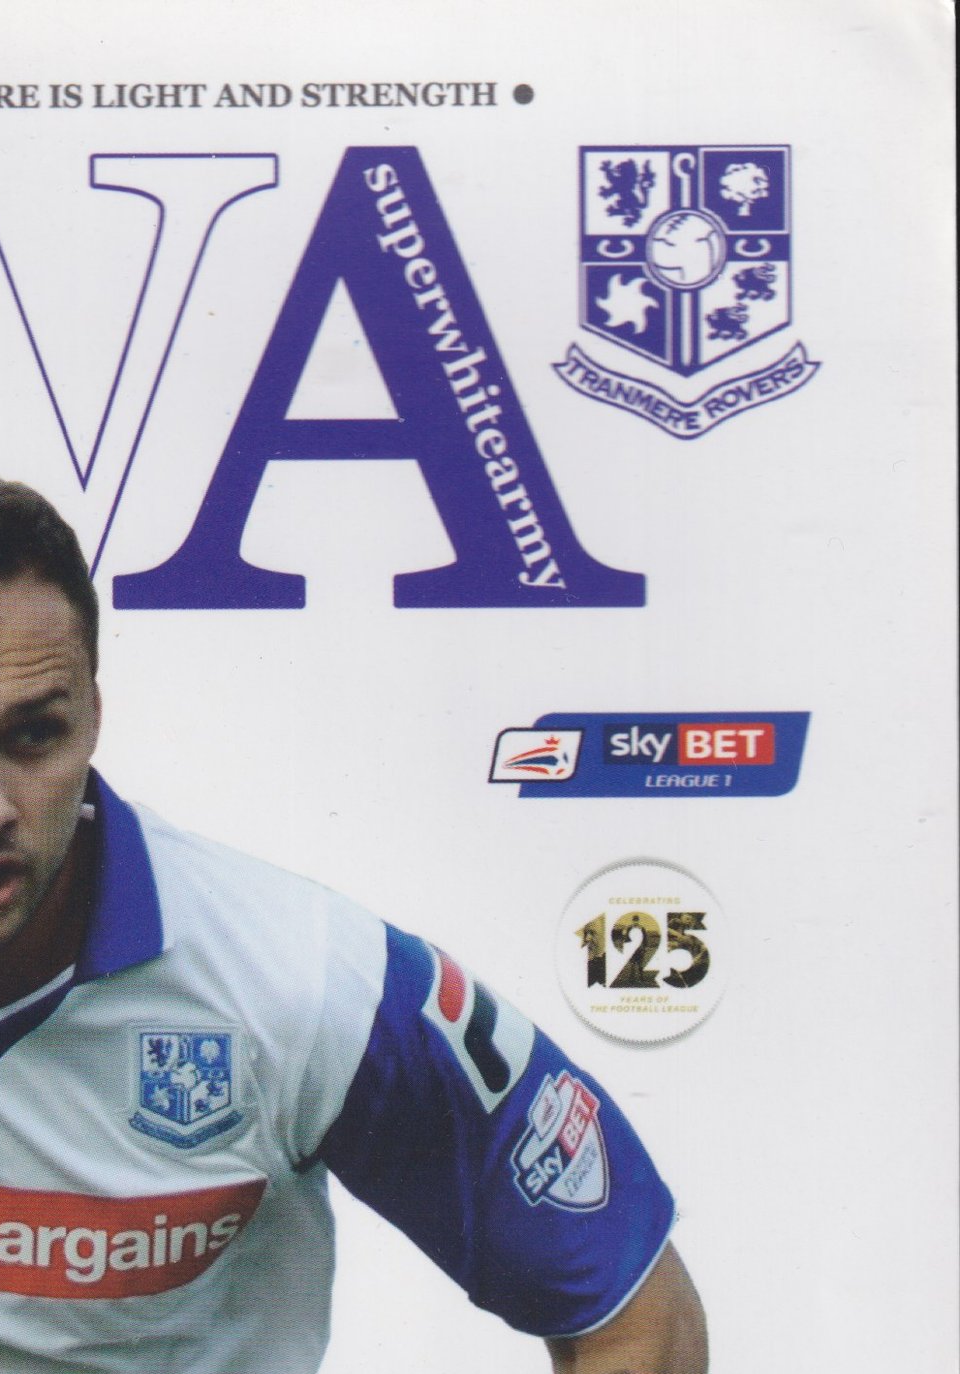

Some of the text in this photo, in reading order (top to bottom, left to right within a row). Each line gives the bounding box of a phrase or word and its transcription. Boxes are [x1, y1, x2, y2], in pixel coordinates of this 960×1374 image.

[49, 84, 82, 109] IS
[92, 84, 207, 108] LIGHT
[216, 83, 293, 108] AND
[301, 82, 498, 108] STRENGTH
[363, 161, 567, 592] superwhitearmy
[567, 355, 804, 430] TRANMERE ROVERS
[610, 726, 764, 762] sky BET
[645, 774, 733, 788] LEAGUE 1
[608, 896, 682, 906] CELEBRATING
[574, 911, 711, 988] 125
[590, 1004, 700, 1014] THE FOOTBALL LEAGUE
[620, 995, 654, 1004] YEARS
